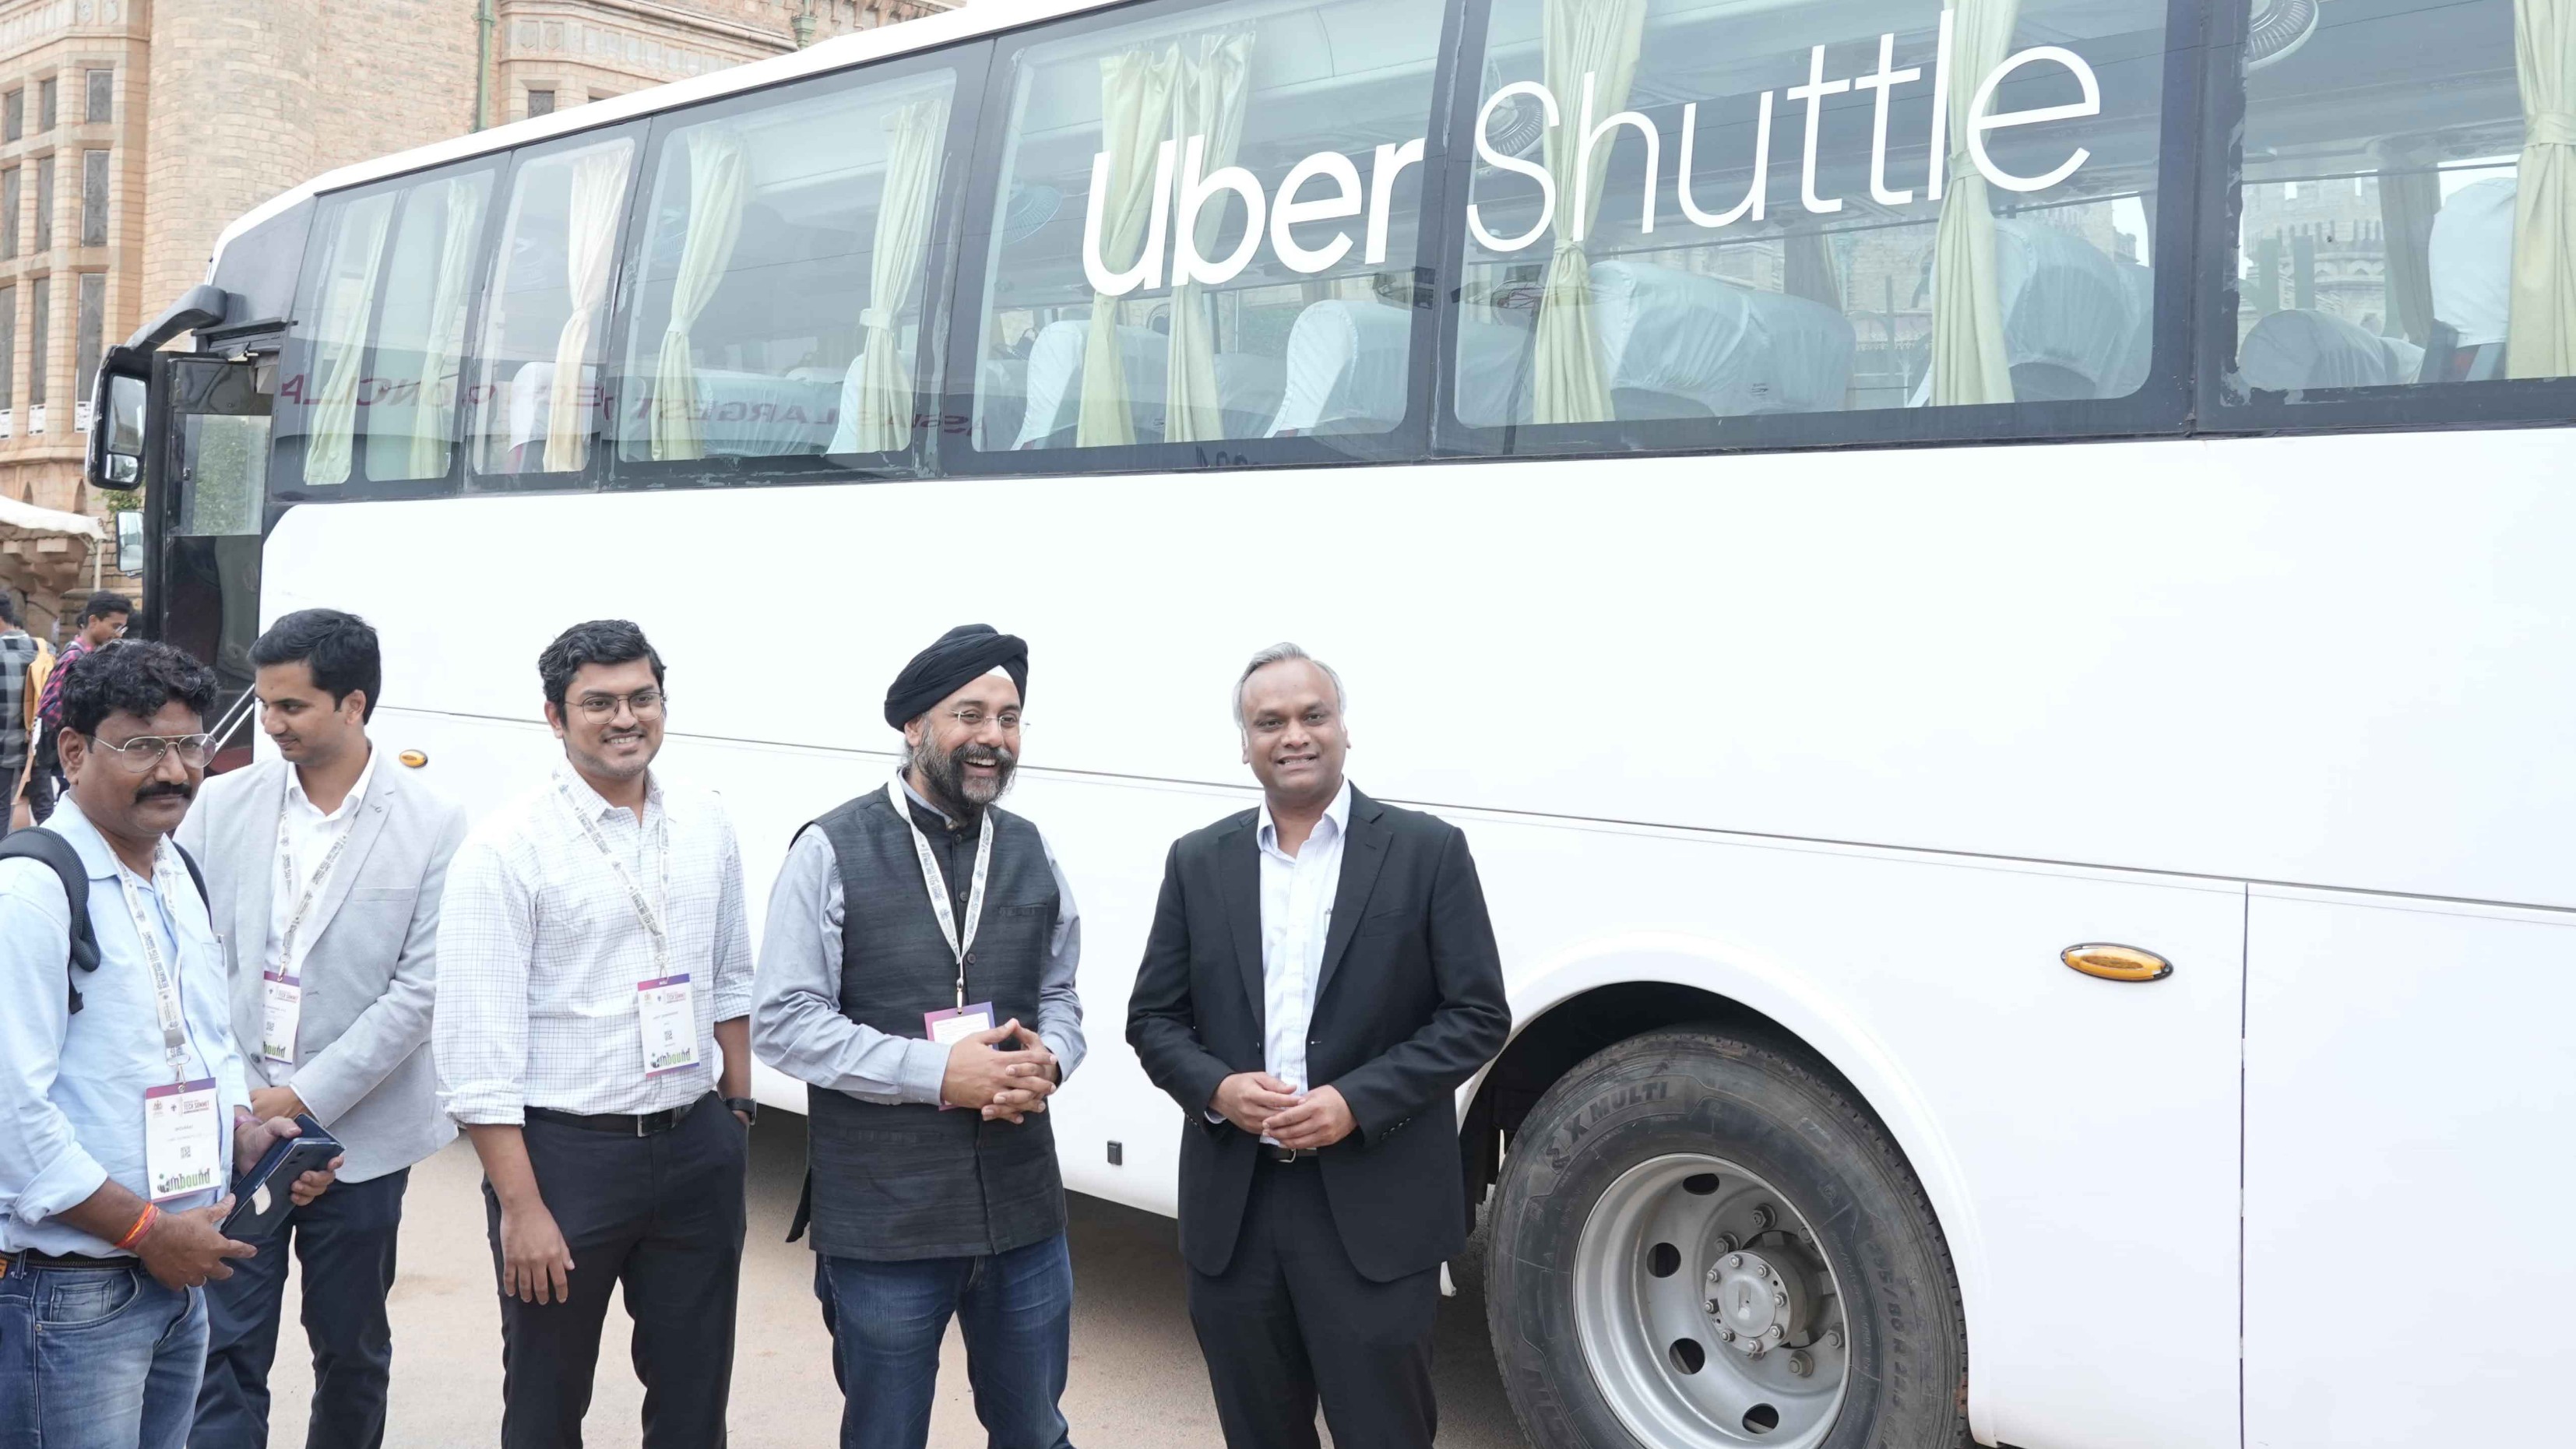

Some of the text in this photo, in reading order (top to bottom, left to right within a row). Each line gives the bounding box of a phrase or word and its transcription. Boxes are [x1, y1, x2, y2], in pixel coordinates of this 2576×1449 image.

[1082, 9, 2100, 297] Uber Shuttle
[1589, 1081, 1669, 1122] MULTI
